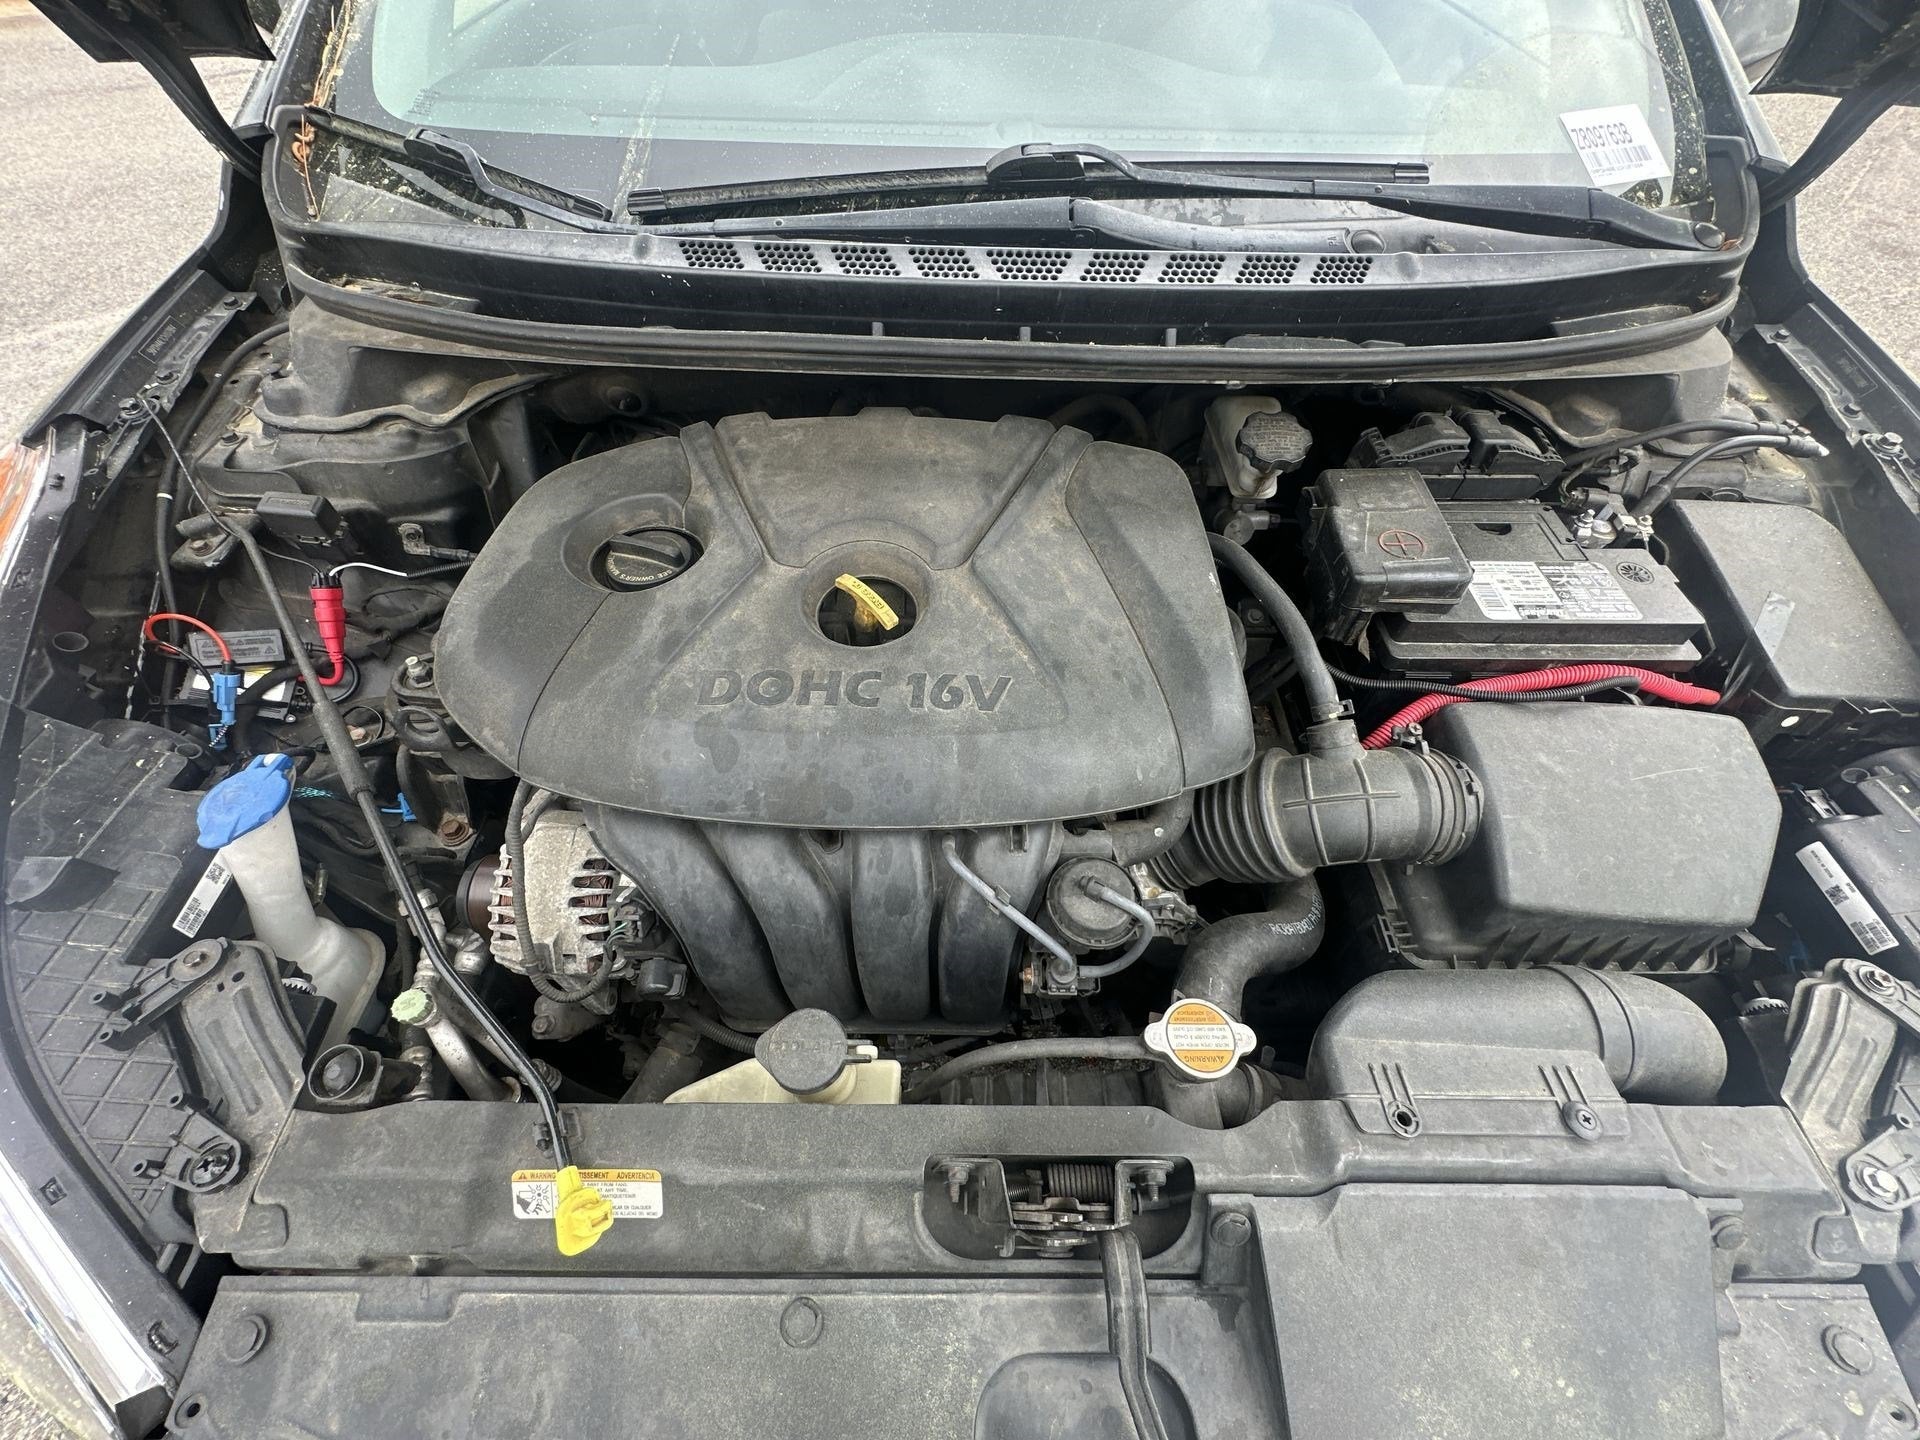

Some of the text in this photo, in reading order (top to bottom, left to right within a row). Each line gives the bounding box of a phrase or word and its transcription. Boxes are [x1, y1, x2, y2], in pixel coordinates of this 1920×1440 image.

[697, 668, 1013, 713] DOHC 16V
[529, 1171, 656, 1180] WARNING TISSEMENT ADVERTENCIA
